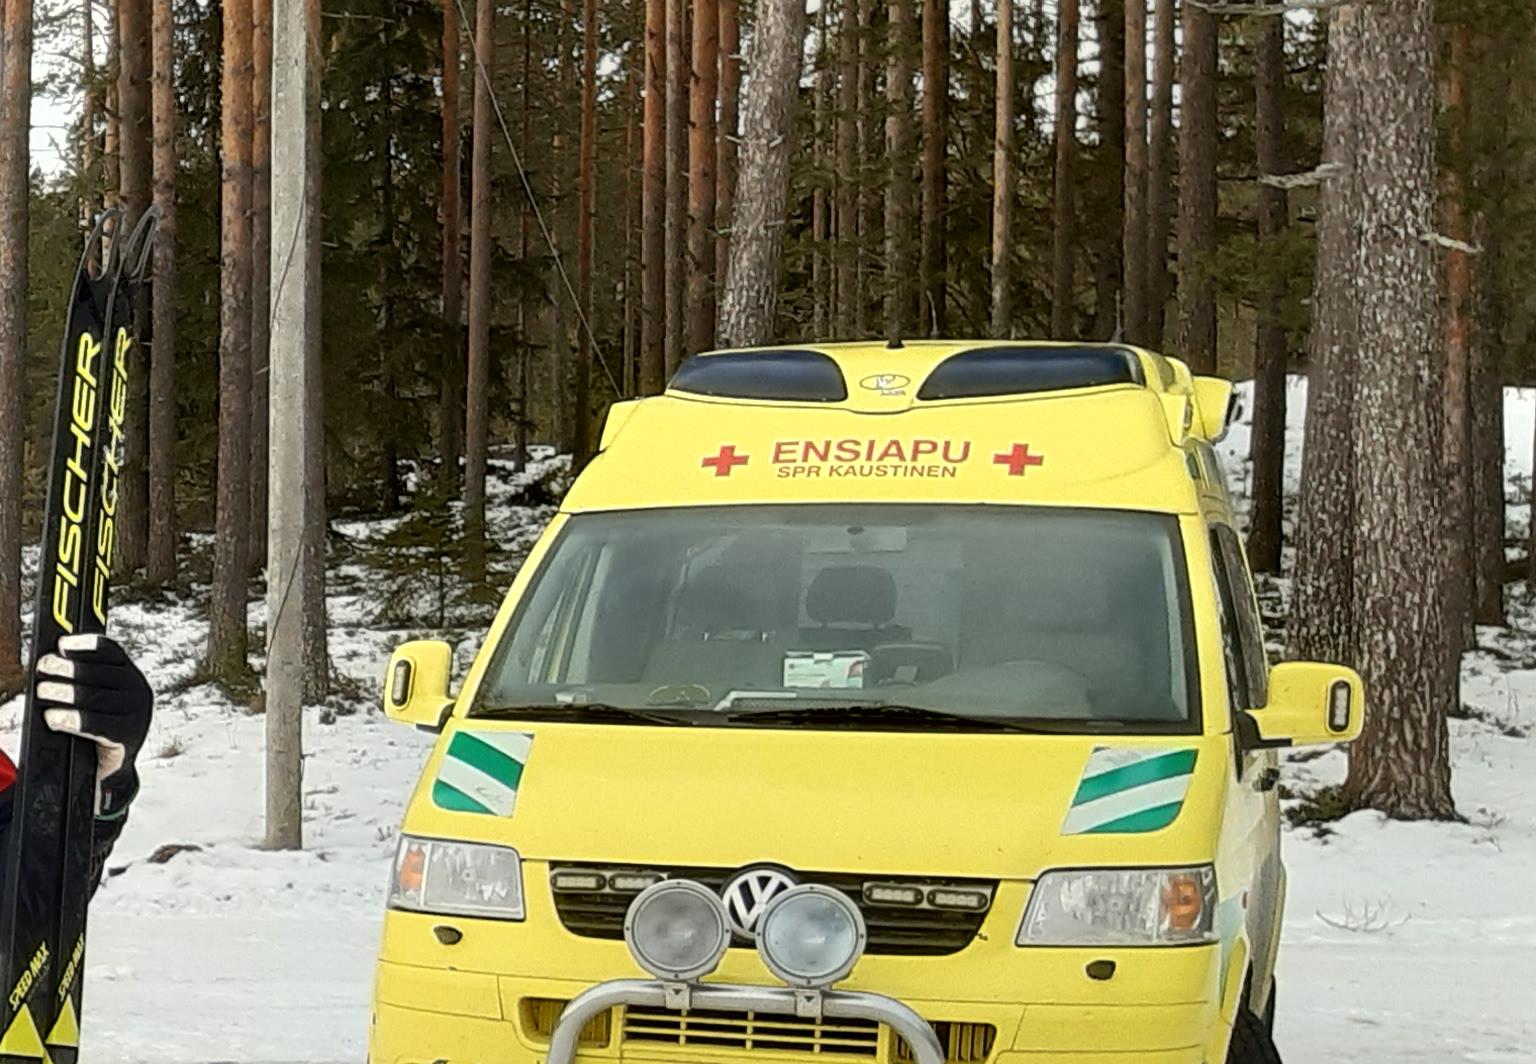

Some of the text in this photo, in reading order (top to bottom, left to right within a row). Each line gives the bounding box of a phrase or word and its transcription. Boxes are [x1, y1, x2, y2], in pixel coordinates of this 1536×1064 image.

[53, 332, 102, 634] FISCHER
[93, 326, 131, 627] FISCHER
[772, 438, 972, 465] ENSIAPU
[777, 464, 958, 478] SPR KAUSTINEN
